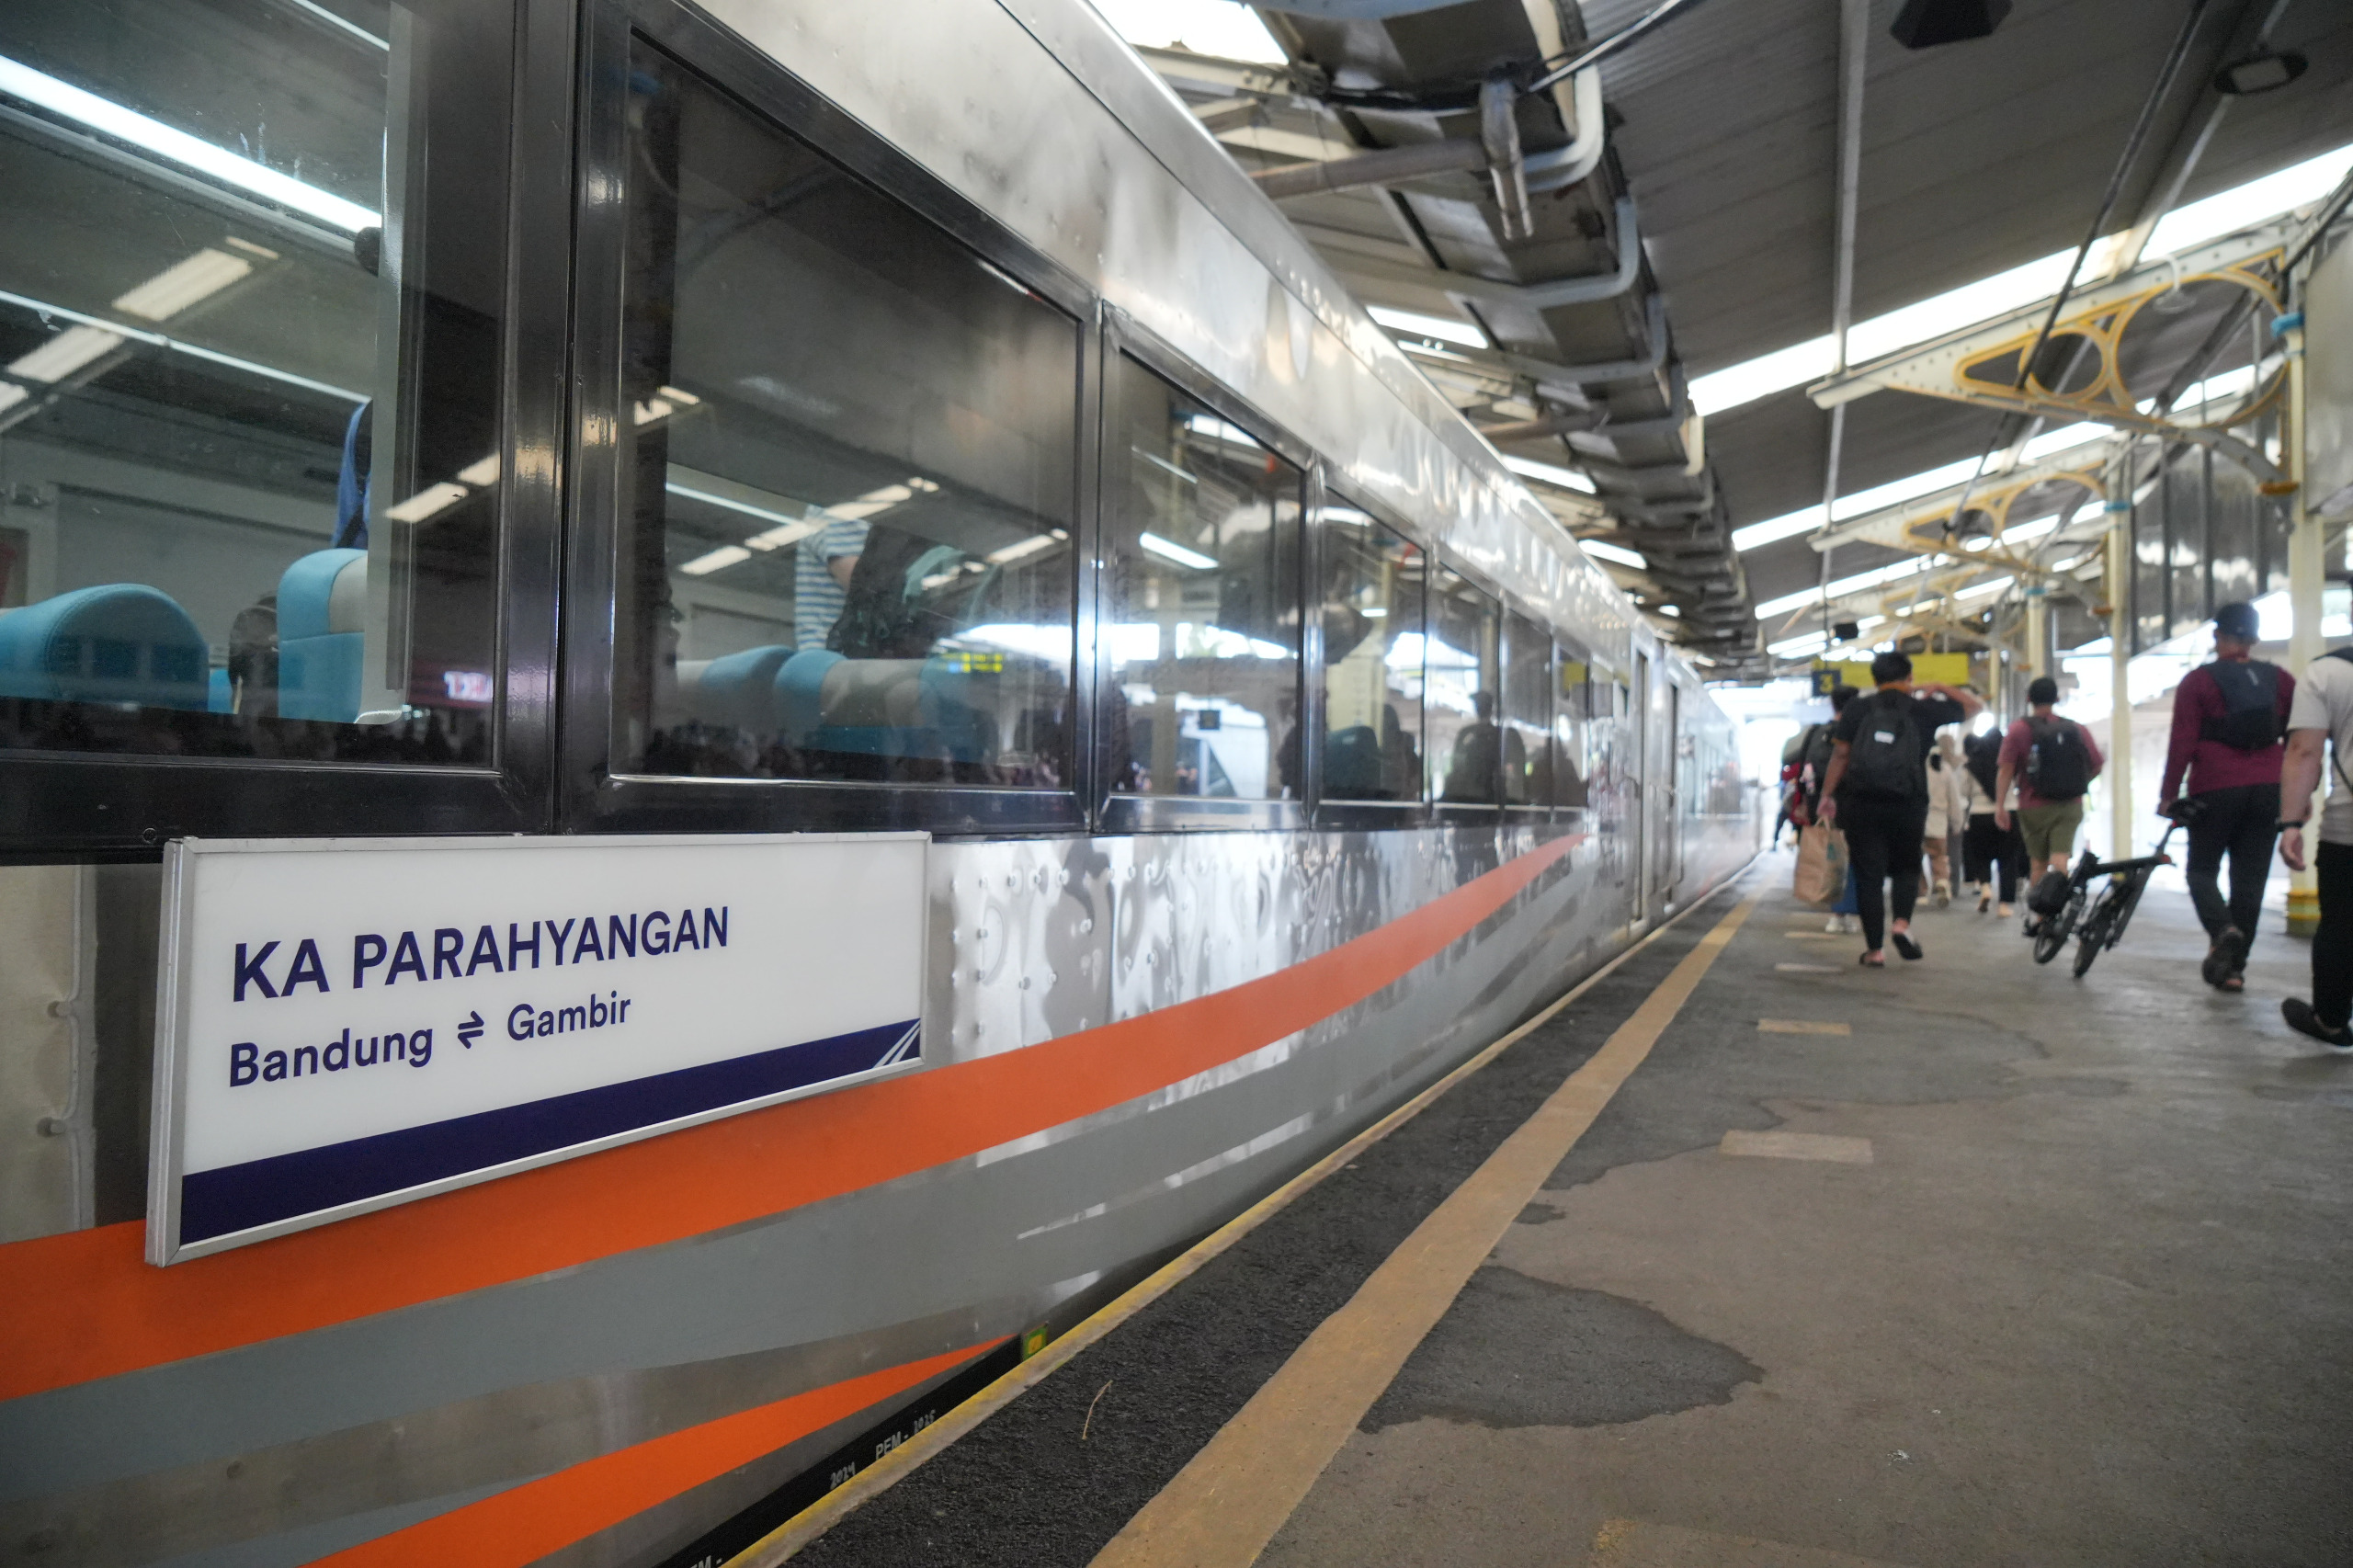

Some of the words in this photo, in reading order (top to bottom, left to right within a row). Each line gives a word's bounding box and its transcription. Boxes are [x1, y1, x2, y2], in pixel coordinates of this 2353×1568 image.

[233, 939, 331, 1002] KA
[353, 905, 729, 989] PARAHYANGAN
[230, 1028, 433, 1087] Bandung
[507, 990, 631, 1041] Gambir
[875, 1430, 901, 1460] PEM
